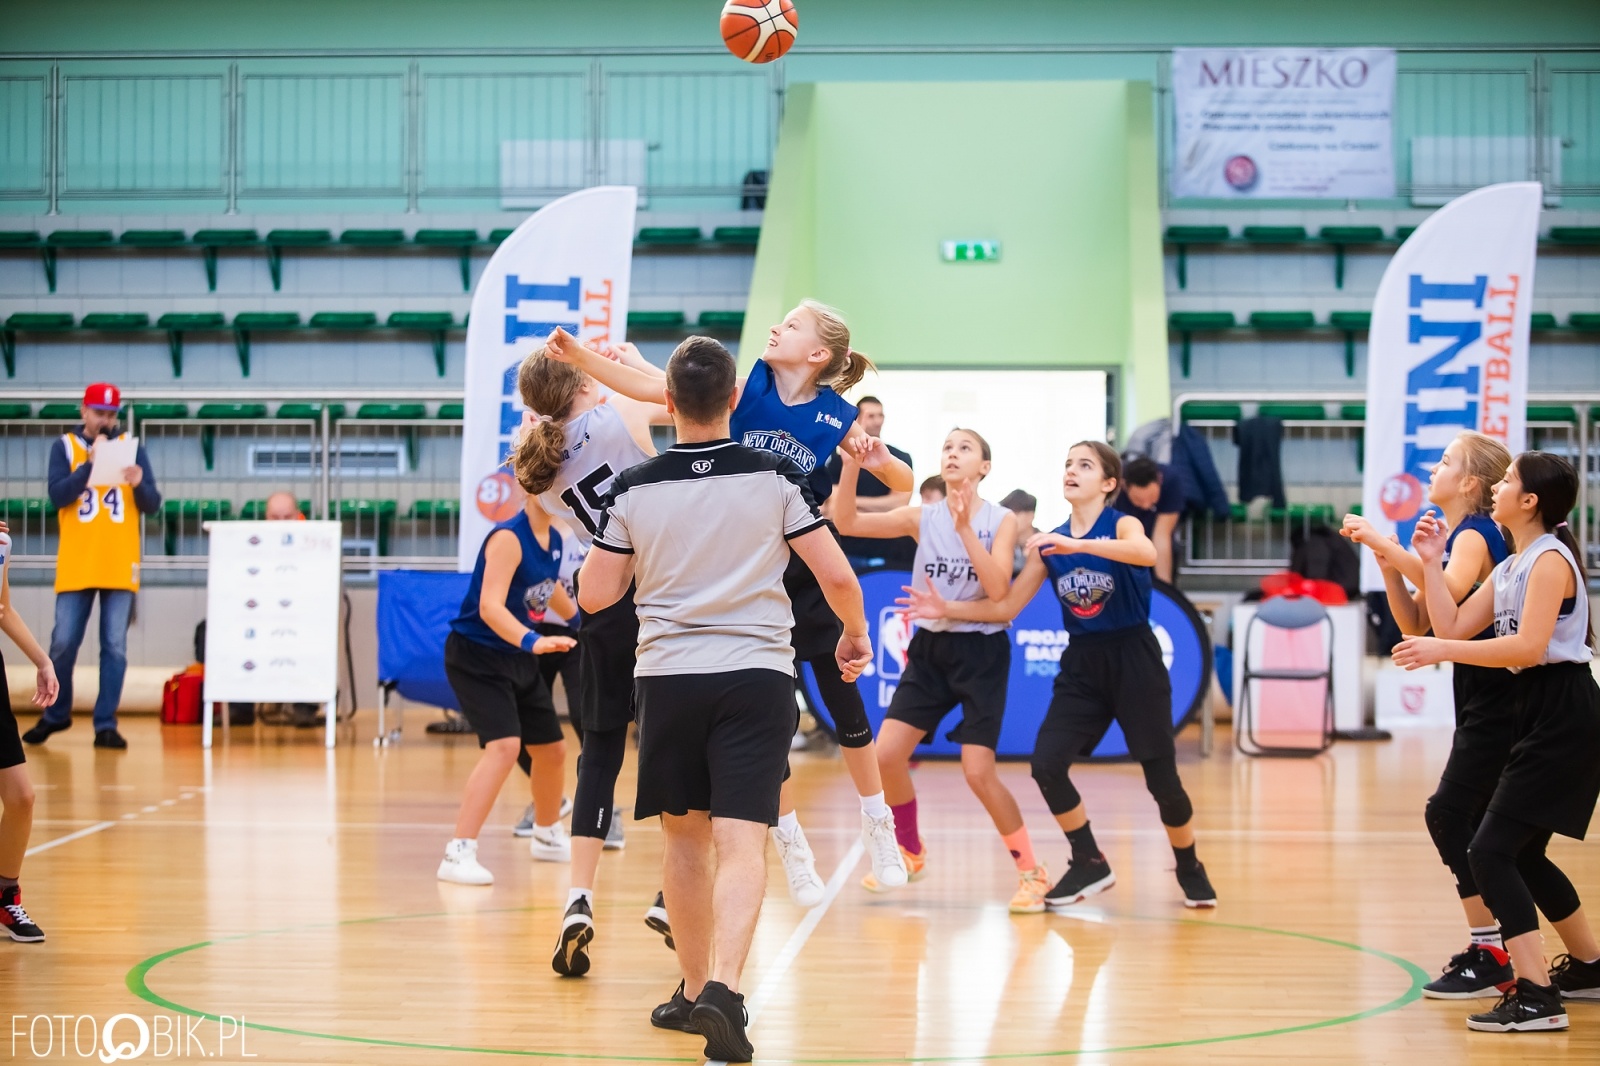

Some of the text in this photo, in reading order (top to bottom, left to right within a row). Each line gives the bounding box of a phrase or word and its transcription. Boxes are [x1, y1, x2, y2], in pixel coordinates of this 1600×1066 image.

[1199, 56, 1369, 89] MIESZKO
[1481, 274, 1521, 450] ETBALL
[743, 432, 816, 473] NEW ORLEANS
[78, 486, 125, 522] 34
[560, 461, 616, 536] 15
[925, 563, 979, 586] SPUR
